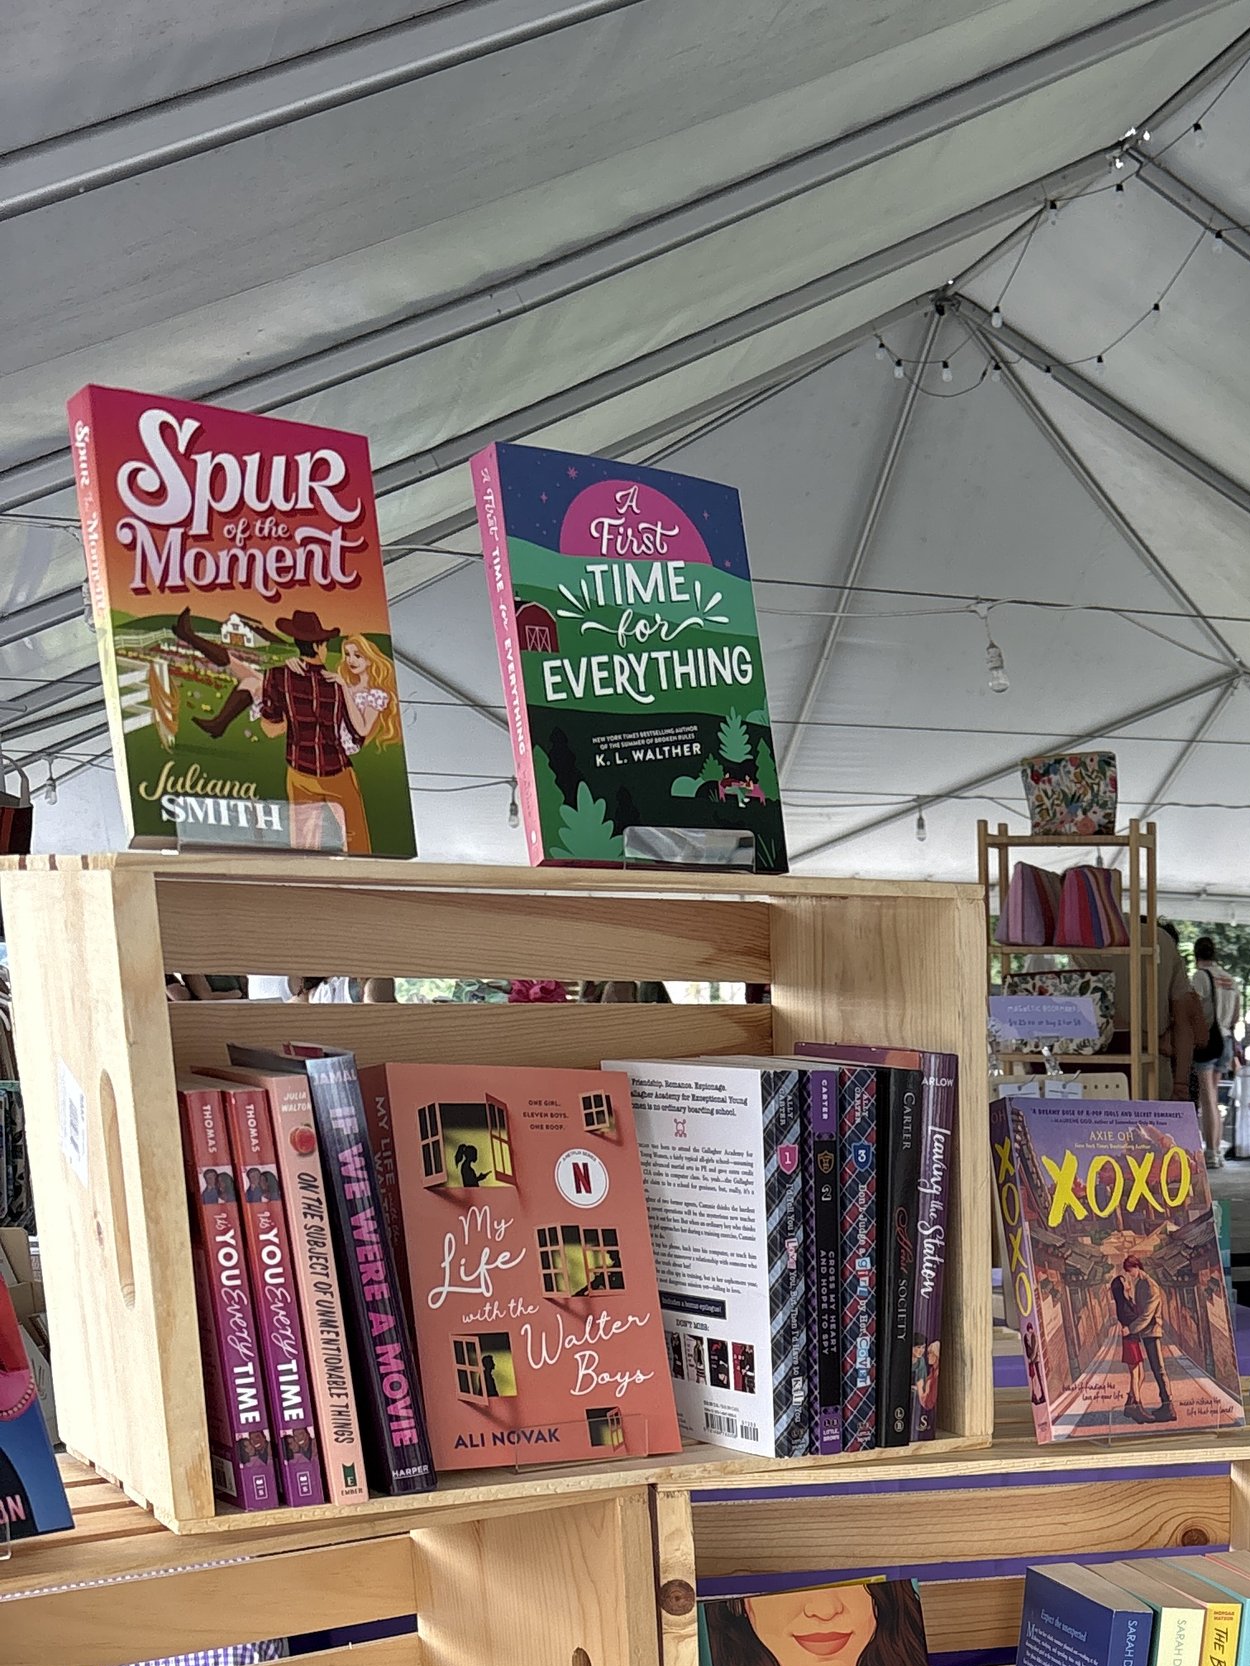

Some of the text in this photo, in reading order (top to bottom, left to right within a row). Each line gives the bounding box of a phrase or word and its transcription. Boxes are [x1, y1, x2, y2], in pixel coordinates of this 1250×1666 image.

[116, 408, 361, 535] Spur
[615, 485, 641, 514] A
[223, 516, 288, 546] of the
[590, 517, 679, 556] First
[116, 517, 364, 597] Moment
[585, 561, 691, 607] TIME
[542, 646, 753, 704] EVERYTHING
[596, 743, 701, 767] K. L. WALTHER
[139, 760, 258, 800] Juliana
[161, 795, 283, 831] SMITH
[281, 1103, 311, 1113] WALTON
[284, 1092, 307, 1101] JULIA
[631, 1090, 653, 1099] allagher
[202, 1104, 217, 1153] THOMAS
[245, 1104, 260, 1153] THOMAS
[1090, 1131, 1134, 1141] AXIE OH
[784, 1152, 791, 1165] 1
[857, 1150, 866, 1162] 3
[821, 1184, 832, 1201] 2
[1042, 1147, 1192, 1228] XOXO
[458, 1206, 514, 1245] My
[994, 1137, 1033, 1317] XOXO
[427, 1232, 527, 1310] Life
[830, 1294, 835, 1311] MY
[520, 1310, 651, 1370] Walter
[822, 1314, 828, 1329] TO
[829, 1315, 837, 1353] HEART
[569, 1350, 656, 1398] Boys
[454, 1427, 561, 1450] ALI NOVAK
[392, 1465, 429, 1477] HARPER
